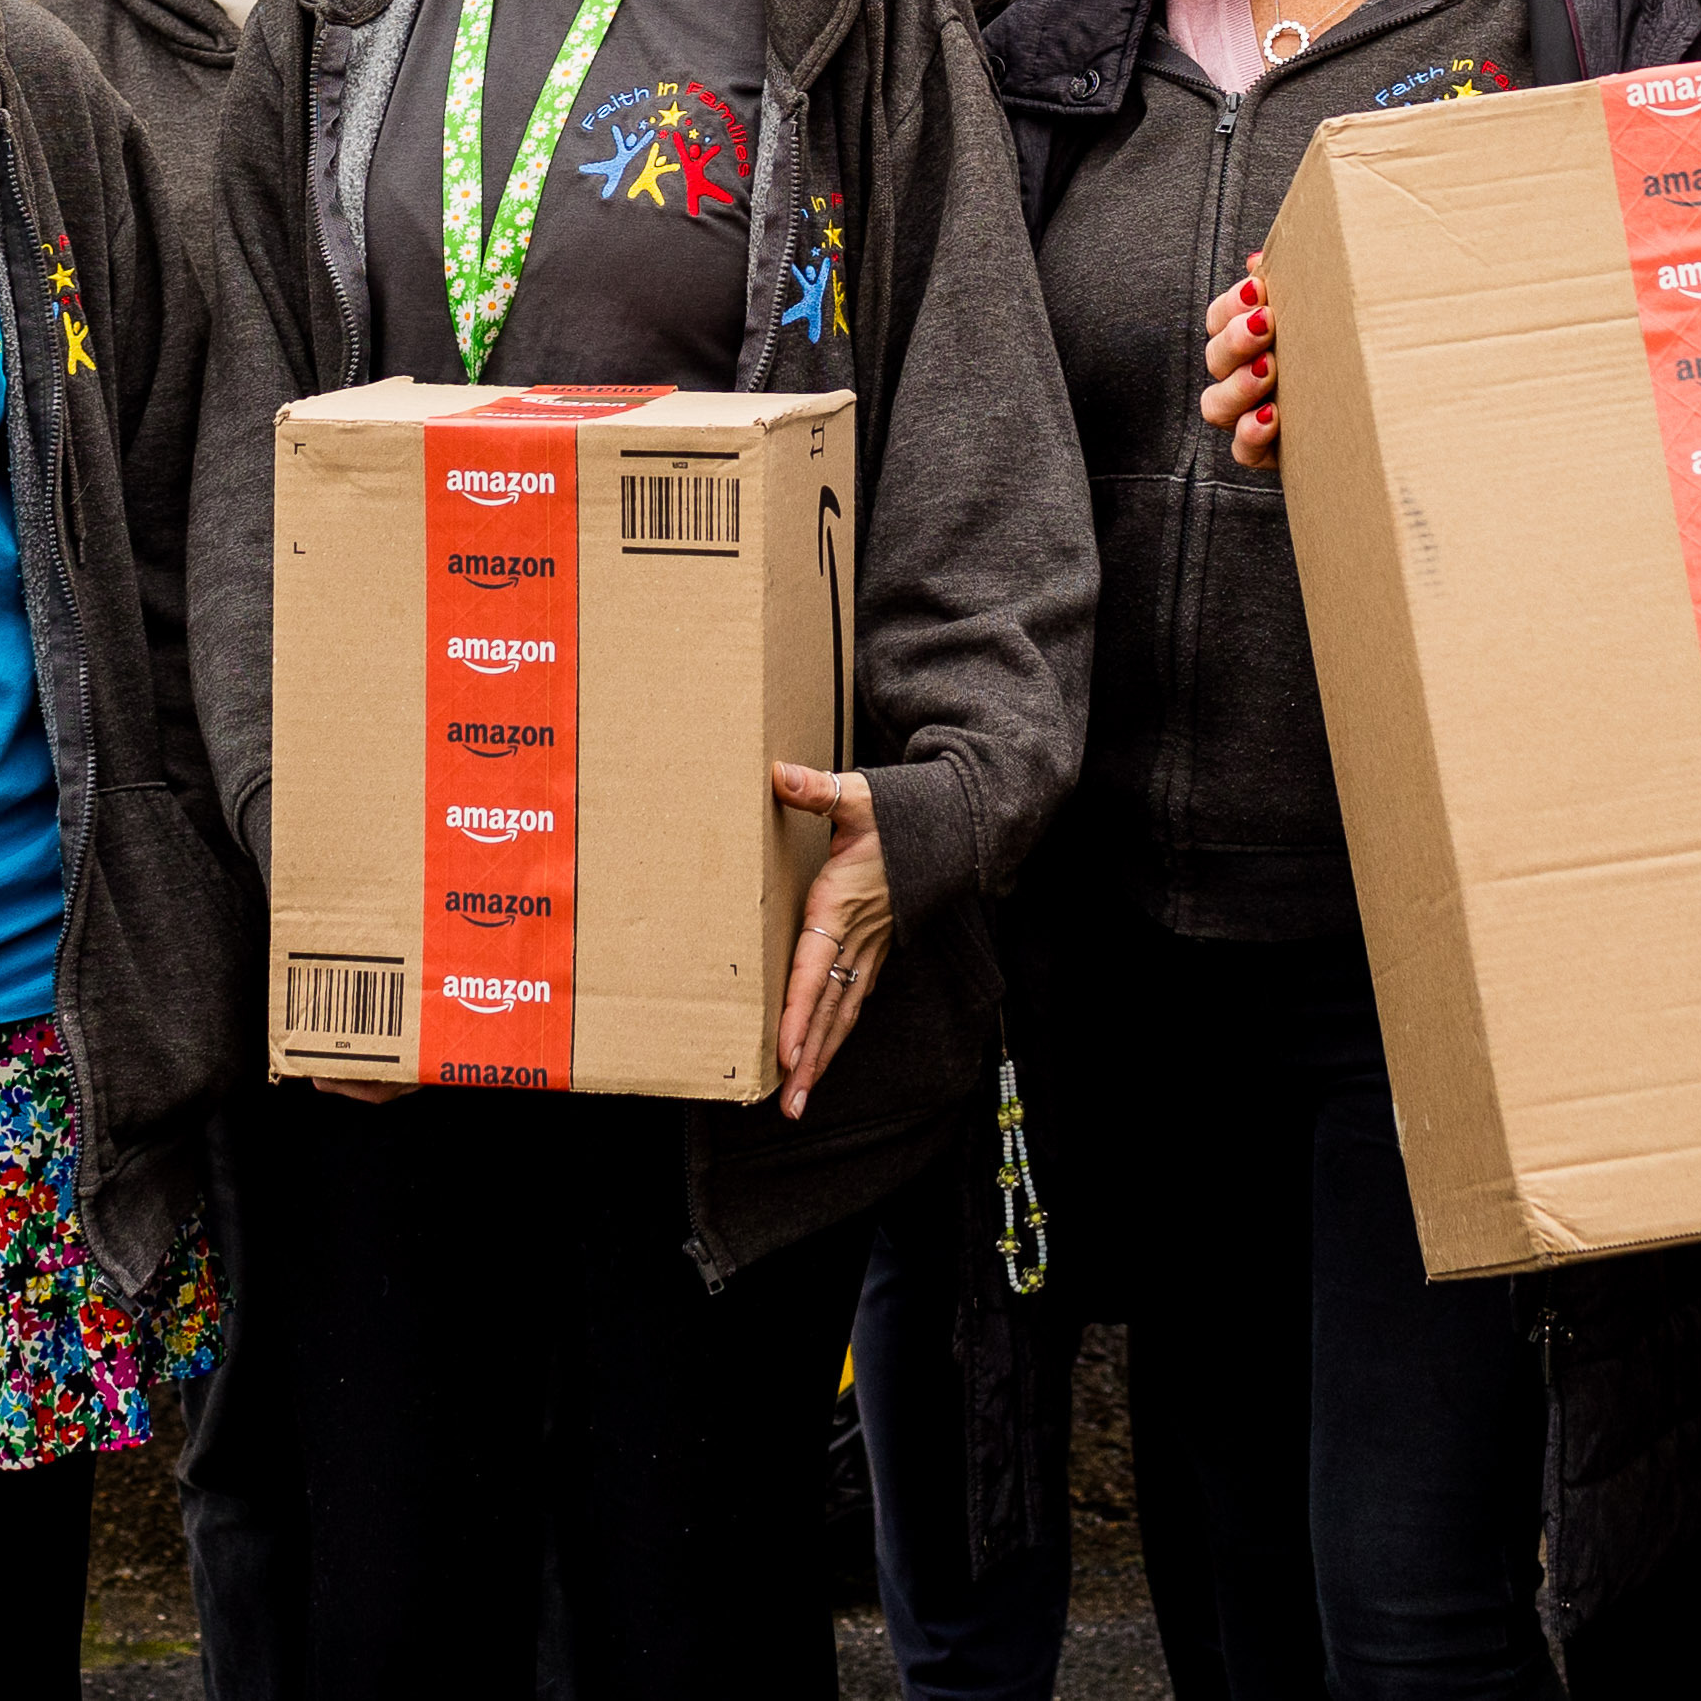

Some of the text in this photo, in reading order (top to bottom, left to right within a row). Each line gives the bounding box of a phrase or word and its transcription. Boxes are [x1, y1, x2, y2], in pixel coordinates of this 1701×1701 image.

[1374, 58, 1474, 107] Faith In
[581, 81, 752, 178] Faith In Families
[446, 468, 556, 496] amazon
[447, 553, 556, 580] amazon
[447, 637, 557, 663] amazon
[446, 721, 556, 748] amazon
[445, 805, 555, 832] amazon
[444, 889, 552, 918] amazon
[442, 973, 551, 1003] amazon
[439, 1061, 548, 1088] amazon
